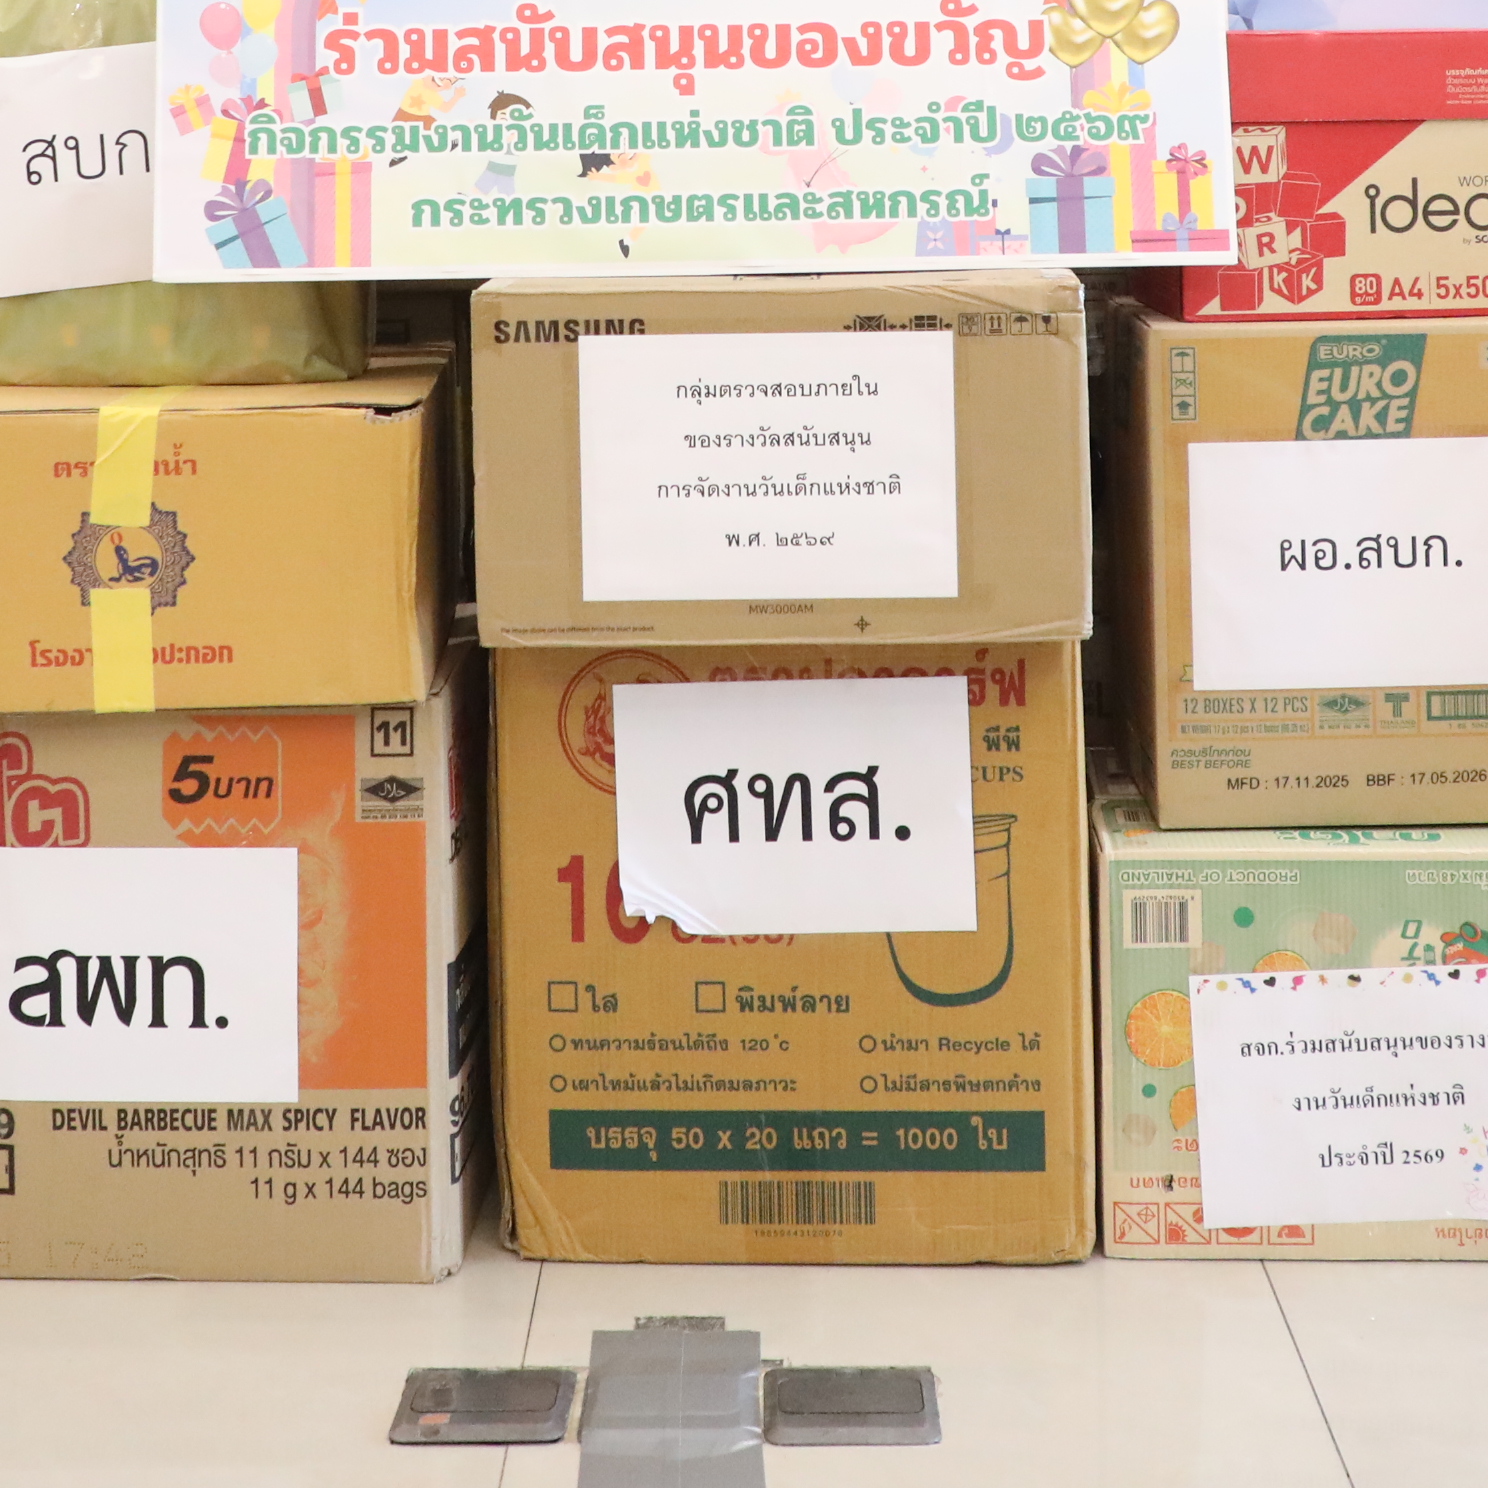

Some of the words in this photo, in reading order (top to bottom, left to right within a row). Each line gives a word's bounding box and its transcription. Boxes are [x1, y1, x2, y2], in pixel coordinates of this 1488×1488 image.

[245, 104, 817, 157] กิจกรรมงานวันเด็กแห่งชาติ
[831, 99, 998, 147] ประจำปี
[1014, 111, 1151, 144] ๒๕๖๙
[411, 173, 991, 229] กระทรวงเกษตรและสหกรณ์
[1354, 277, 1378, 294] 80
[1387, 277, 1424, 301] A4
[1318, 342, 1382, 362] EURO
[675, 374, 879, 407] กลุ่มตรวจสอบภายใน
[1307, 361, 1417, 405] EURO
[1301, 399, 1412, 440] CAKE
[684, 426, 872, 454] ของรางวัลสนับสนุน
[656, 472, 902, 500] การจัดงานวันเด็กแห่งชาติ
[724, 527, 767, 549] พ.ศ.
[775, 528, 836, 548] ๒๕๖๙
[1279, 533, 1463, 572] ผอ.สบก.
[1183, 698, 1199, 714] 12
[1204, 697, 1244, 714] BOXES
[1250, 697, 1257, 714] X
[1264, 697, 1278, 713] 12
[1283, 696, 1309, 713] PCS
[376, 720, 408, 747] 11
[982, 725, 1021, 752] พีพี
[1171, 759, 1200, 769] BEST
[1205, 759, 1252, 769] BEFORE
[1227, 776, 1259, 791] MFD
[1274, 774, 1349, 789] 17.11.2025
[1366, 773, 1395, 787] BBF
[1410, 769, 1487, 785] 17.05.2026
[683, 765, 913, 845] ศทส.
[1119, 868, 1194, 885] THAILAND
[1199, 869, 1223, 885] OF
[1225, 869, 1300, 885] PRODUCT
[1405, 869, 1437, 885] ขวด
[1439, 870, 1458, 885] 48
[586, 984, 618, 1013] ใส
[735, 985, 851, 1014] พิมพ์ลาย
[570, 1032, 729, 1052] ทนความร้อนได้ถึง
[740, 1038, 769, 1052] 120
[881, 1032, 929, 1052] นำมา
[938, 1037, 1011, 1055] Recycle
[1018, 1032, 1041, 1052] ได้
[572, 1073, 798, 1093] เผาไหม้แล้วไม่เกิดมลภาวะ
[881, 1073, 1042, 1093] ไม่มีสารพิษตกค้าง
[1292, 1084, 1466, 1112] งานวันเด็กแห่งชาติ
[52, 1108, 108, 1132] DEVIL
[117, 1109, 217, 1133] BARBECUE
[226, 1109, 270, 1133] MAX
[282, 1109, 338, 1133] SPICY
[349, 1108, 426, 1132] FLAVOR
[587, 1124, 657, 1161] บรรจุ
[671, 1129, 704, 1150] 50
[718, 1134, 733, 1150] x
[745, 1129, 778, 1150] 20
[793, 1127, 848, 1151] แถว
[896, 1129, 959, 1150] 1000
[971, 1116, 1008, 1150] ใบ
[107, 1134, 226, 1176] น้ำหนักสุทธิ
[235, 1147, 257, 1169] 11
[267, 1142, 312, 1169] กรัม
[318, 1153, 331, 1168] x
[339, 1147, 379, 1169] 144
[386, 1146, 427, 1169] ซอง
[1318, 1144, 1394, 1169] ประจำปี
[1401, 1148, 1445, 1166] 2569
[250, 1178, 275, 1199] 11
[284, 1182, 298, 1204] g
[305, 1183, 318, 1199] x
[326, 1177, 367, 1199] 144
[373, 1176, 427, 1204] bags
